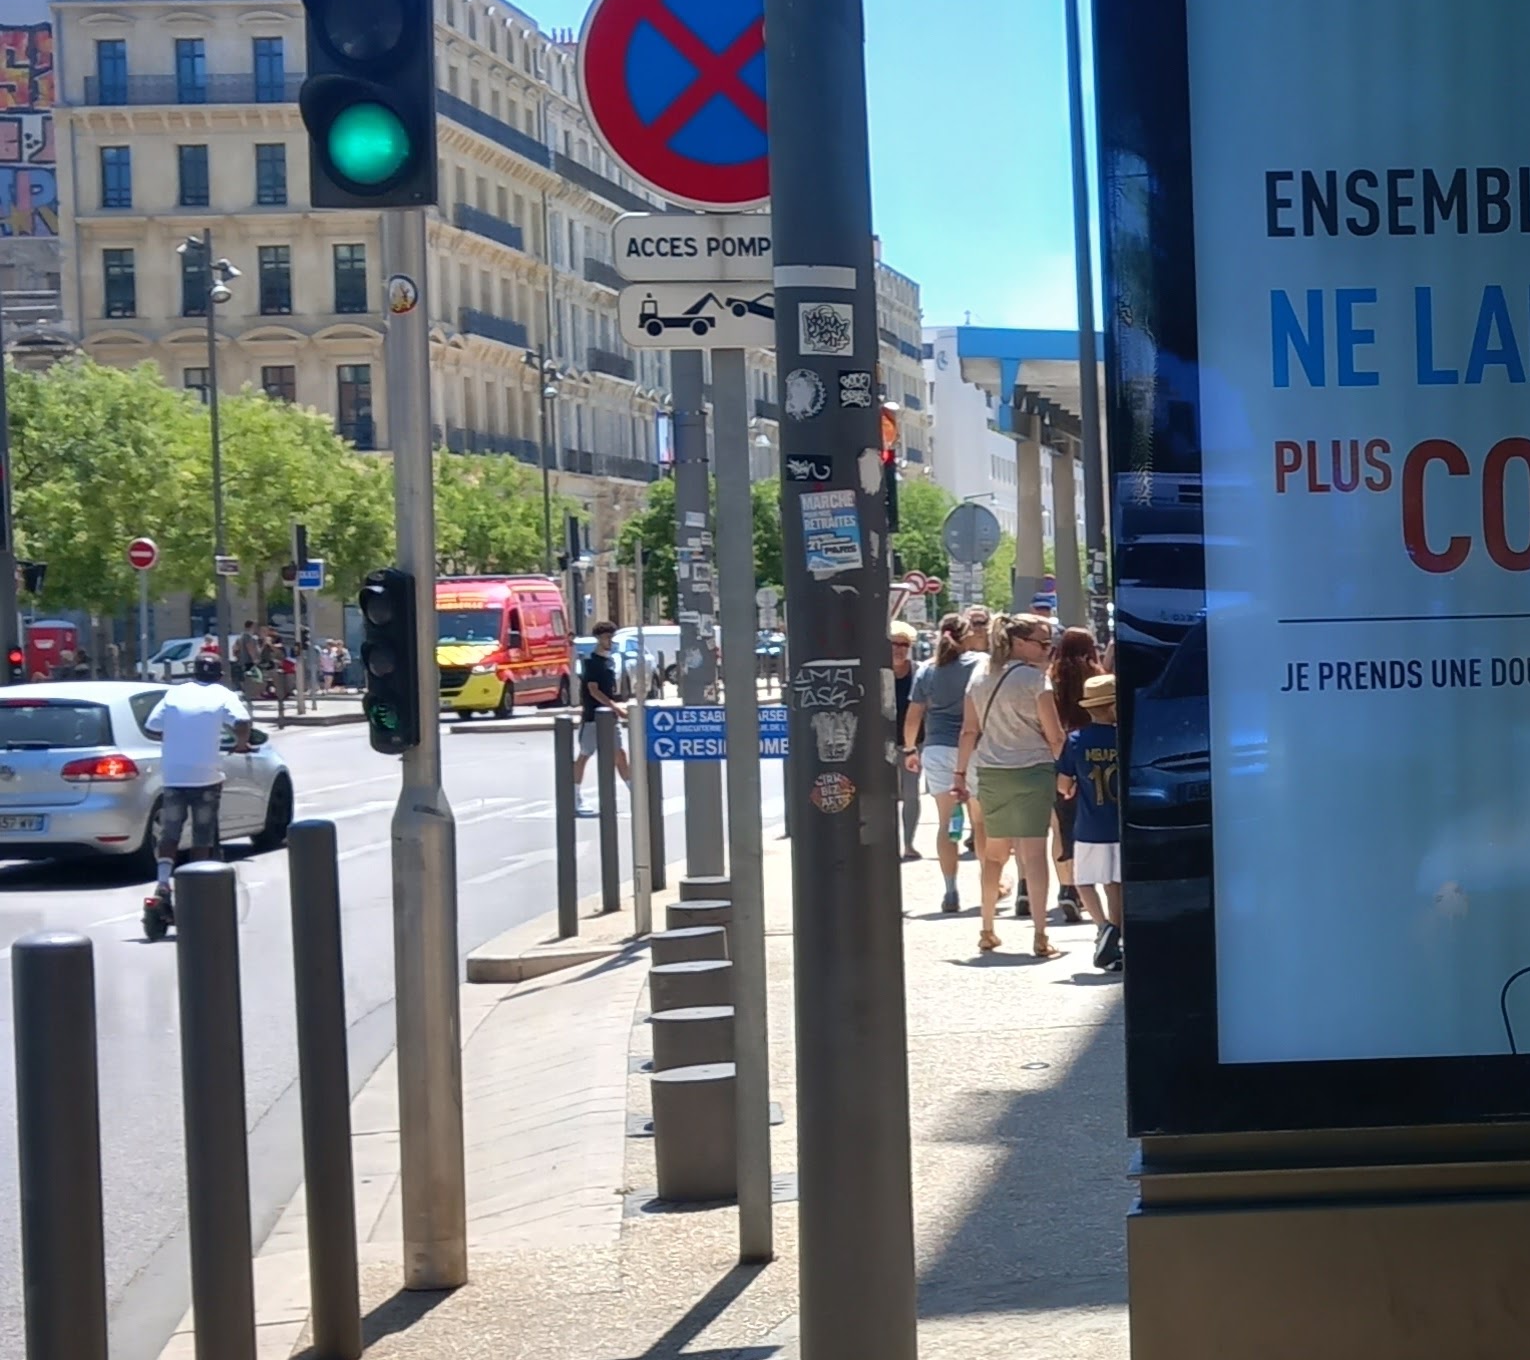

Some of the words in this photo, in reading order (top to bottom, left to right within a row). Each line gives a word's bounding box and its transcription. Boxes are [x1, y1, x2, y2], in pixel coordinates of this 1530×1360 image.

[626, 237, 698, 258] ACCES
[1270, 287, 1381, 389] NE
[1275, 438, 1393, 494] PLUS
[801, 493, 855, 510] MARCHE
[804, 515, 857, 531] RETRAITES
[1281, 662, 1310, 692] JE
[1319, 659, 1424, 691] PRENDS
[1431, 658, 1482, 689] UNE
[675, 710, 697, 723] LES
